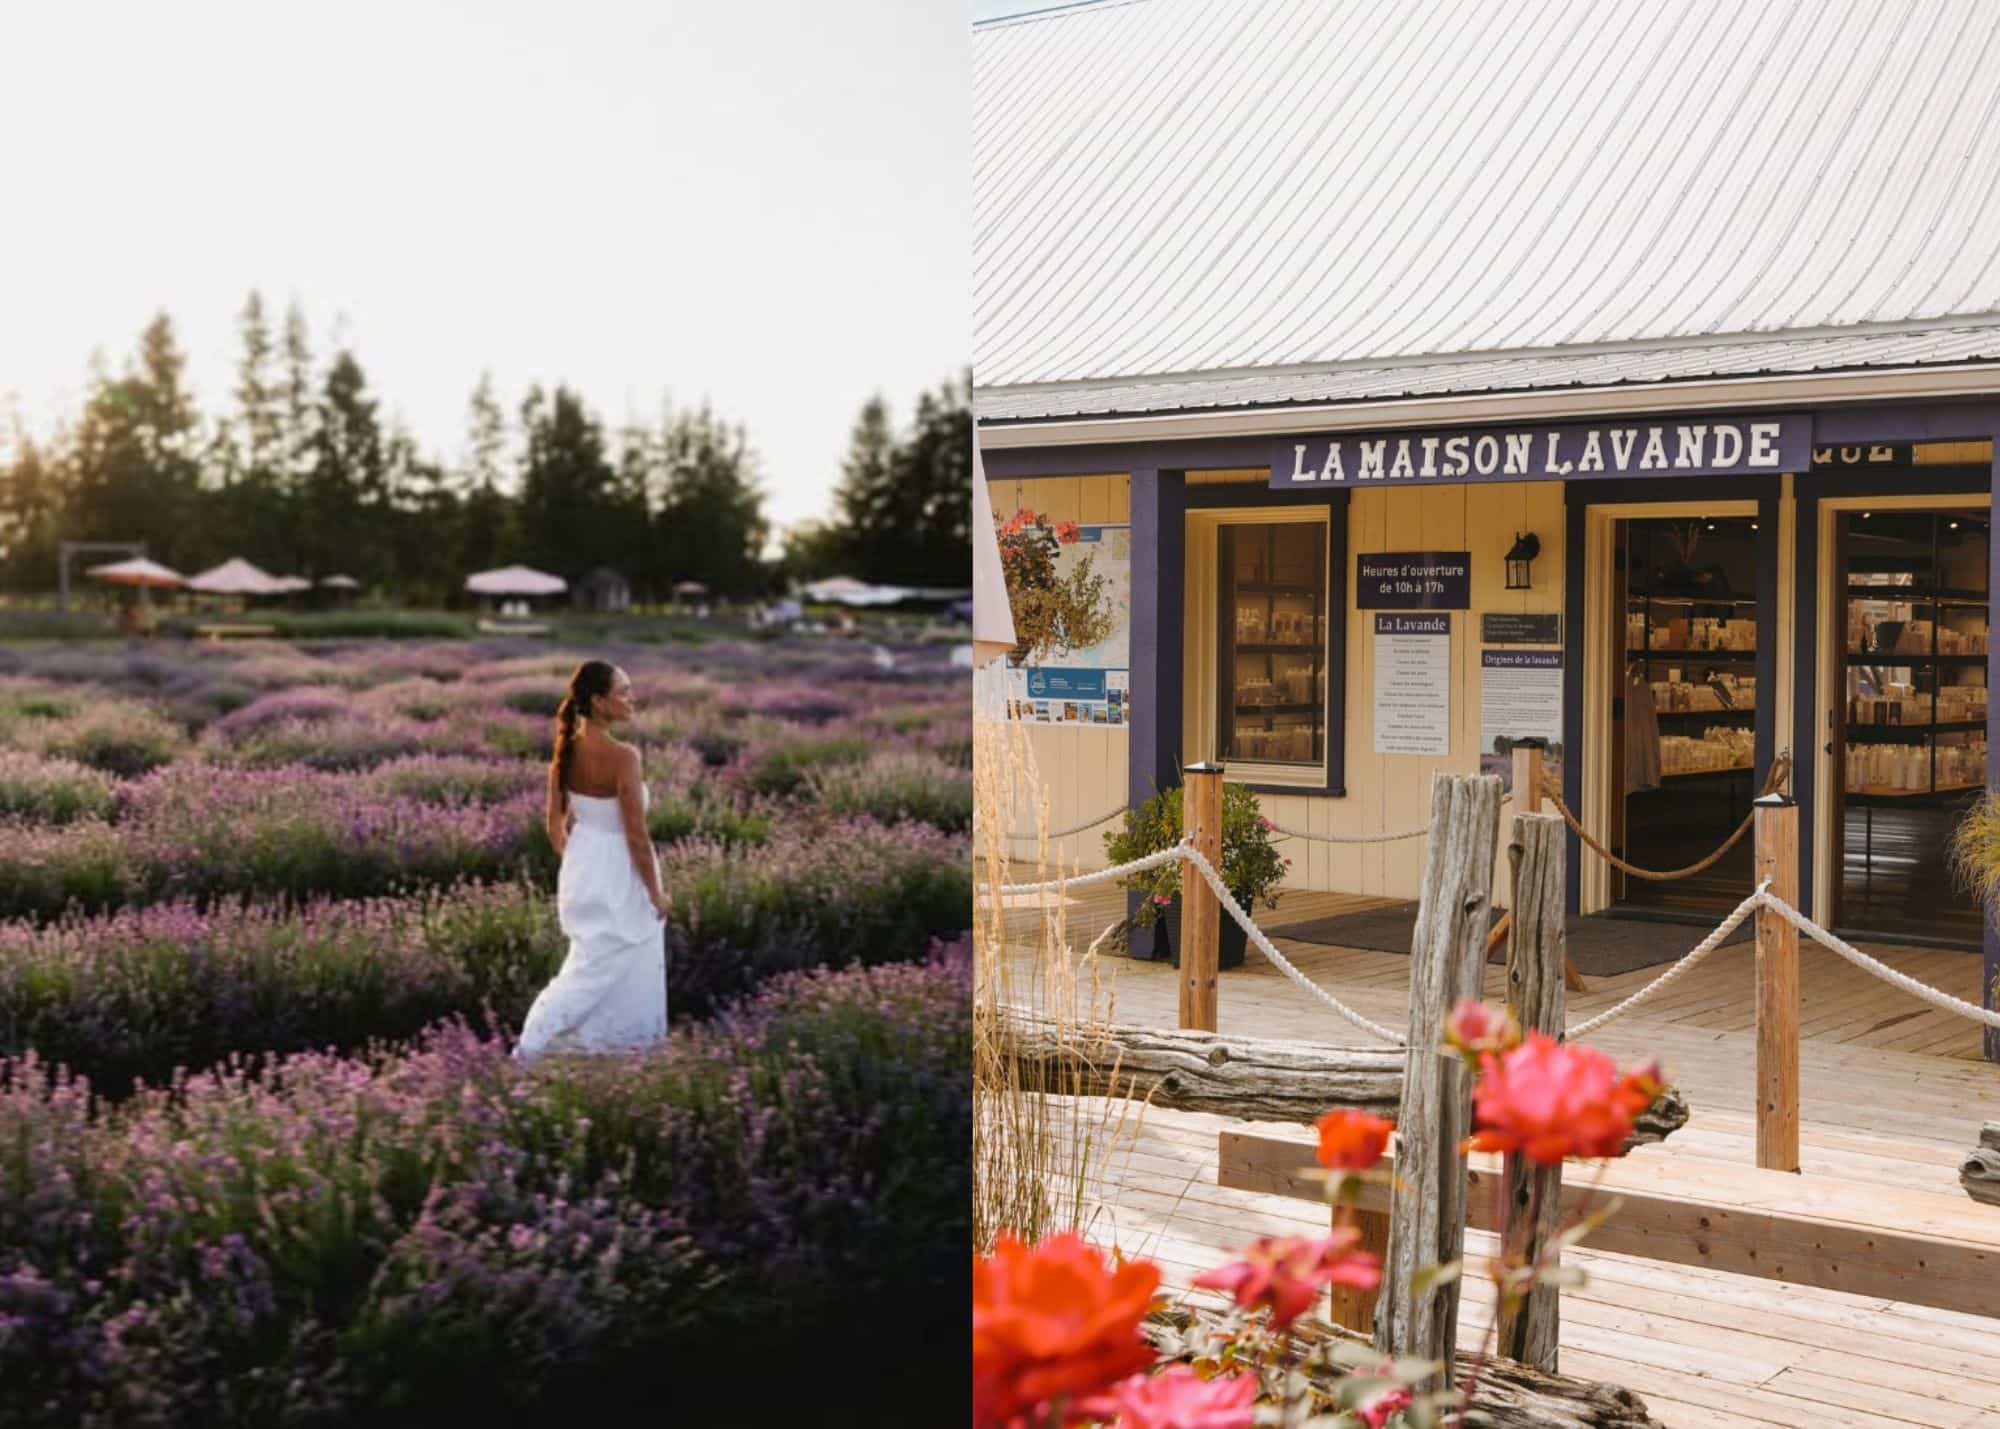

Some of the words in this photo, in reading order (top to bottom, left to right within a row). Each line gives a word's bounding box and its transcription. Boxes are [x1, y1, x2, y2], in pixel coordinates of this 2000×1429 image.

[1292, 442, 1345, 481] LA
[1358, 434, 1533, 479] MAISON
[1545, 423, 1780, 475] LAVANDE
[1363, 565, 1399, 577] Heures
[1401, 564, 1464, 577] d'ouverture
[1380, 582, 1392, 593] de
[1395, 582, 1413, 593] 10h
[1425, 581, 1444, 593] 17h
[1378, 618, 1392, 631] La
[1396, 617, 1446, 631] Lavande
[1485, 654, 1514, 665] Origines
[1514, 654, 1524, 664] de
[1524, 655, 1530, 664] la
[1531, 655, 1559, 665] lavande
